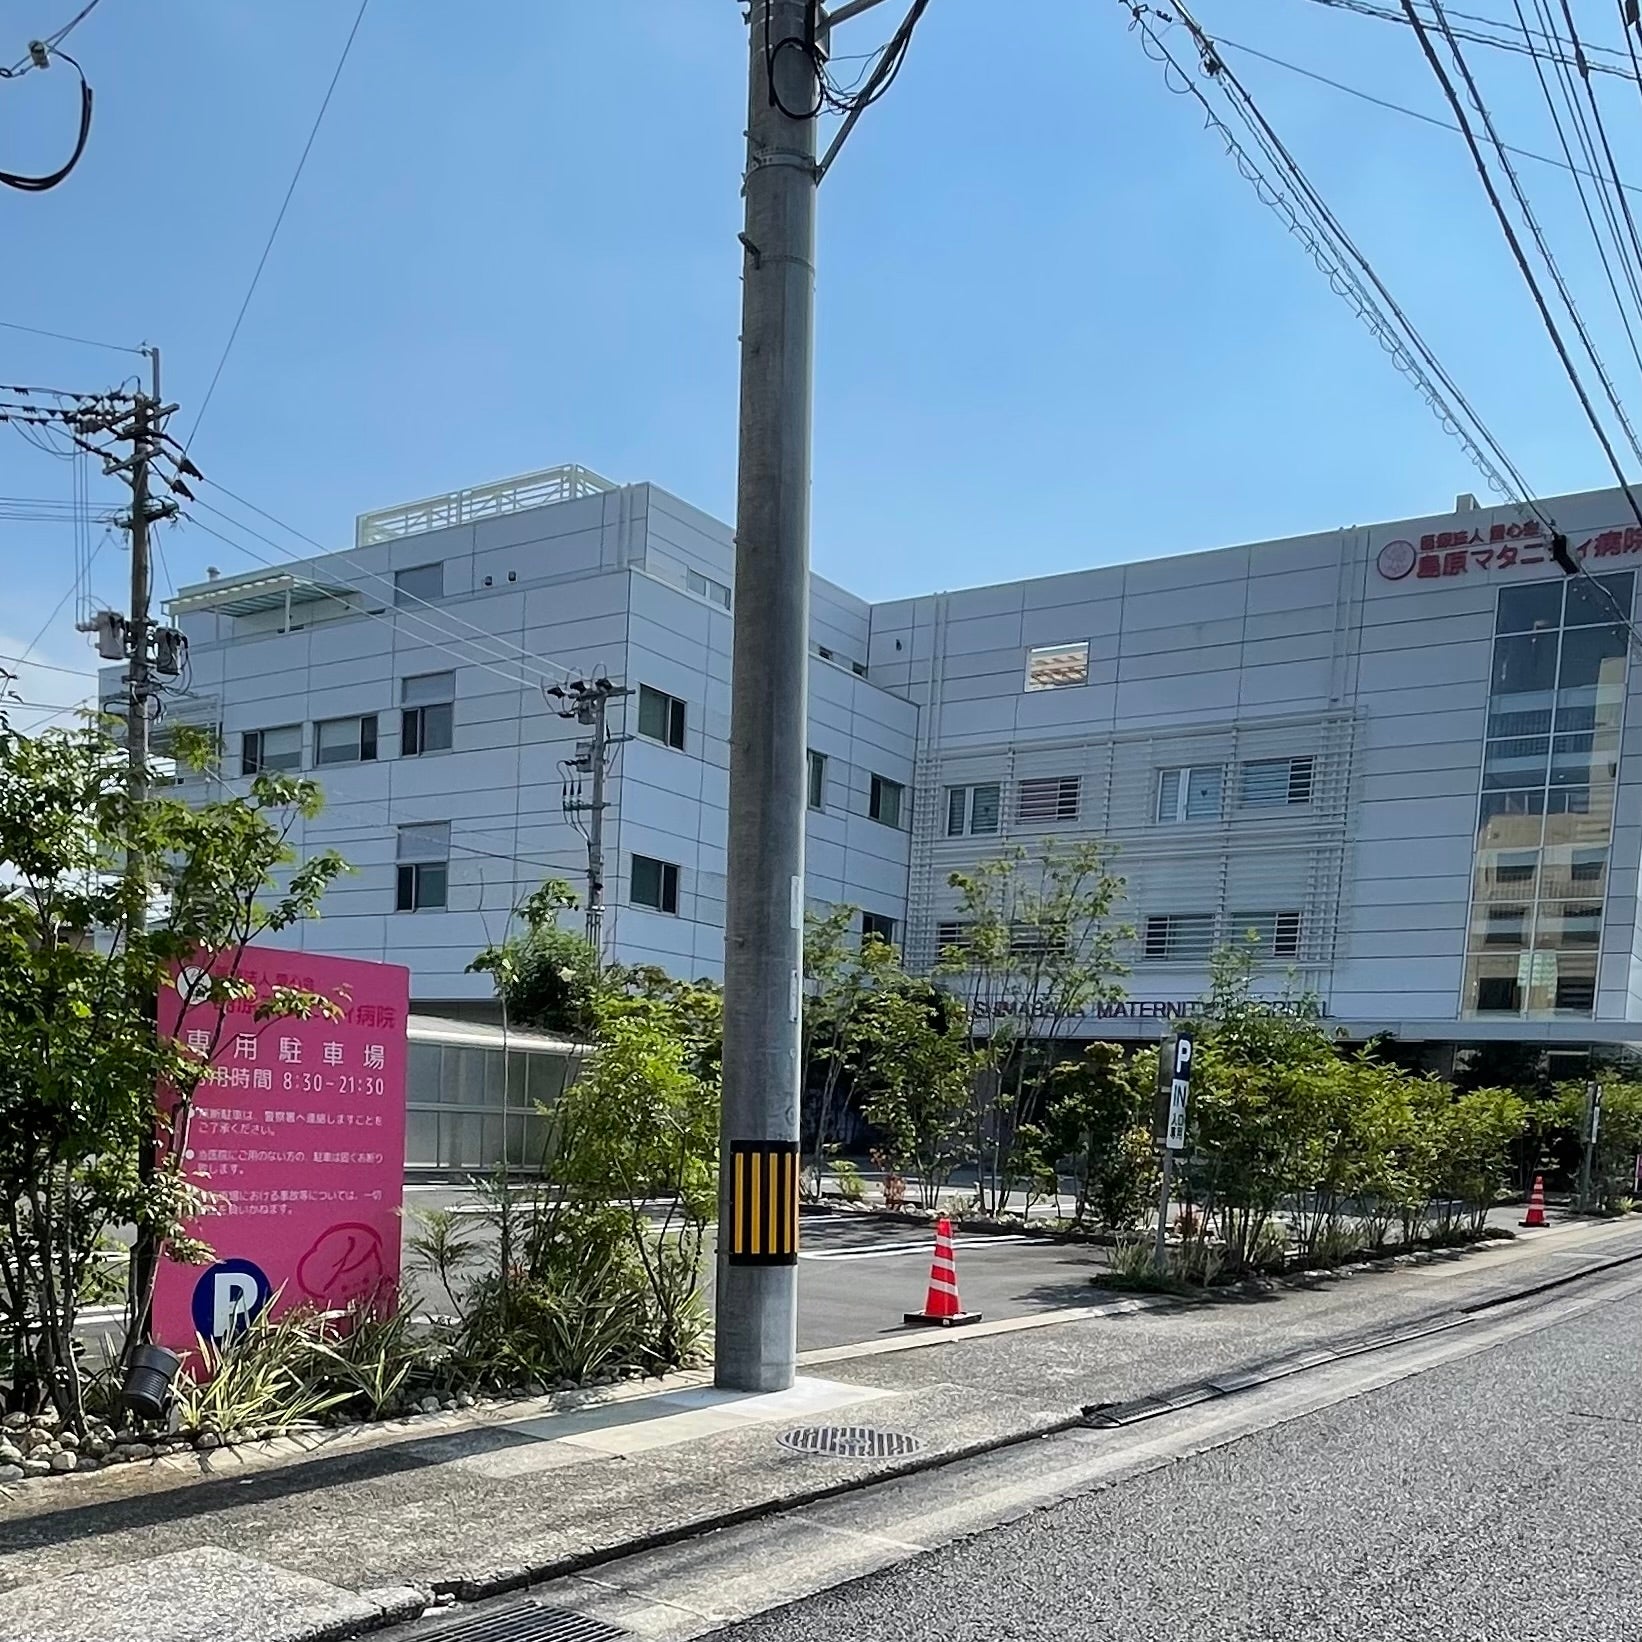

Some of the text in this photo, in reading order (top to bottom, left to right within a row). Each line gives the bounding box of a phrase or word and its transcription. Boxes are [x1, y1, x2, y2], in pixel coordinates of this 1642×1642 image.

[1416, 526, 1642, 578] 島原マタニィ病院
[1097, 1000, 1216, 1019] MATERNIT
[1176, 1039, 1191, 1073] P
[196, 1066, 272, 1090] 用時間
[213, 1272, 259, 1337] P
